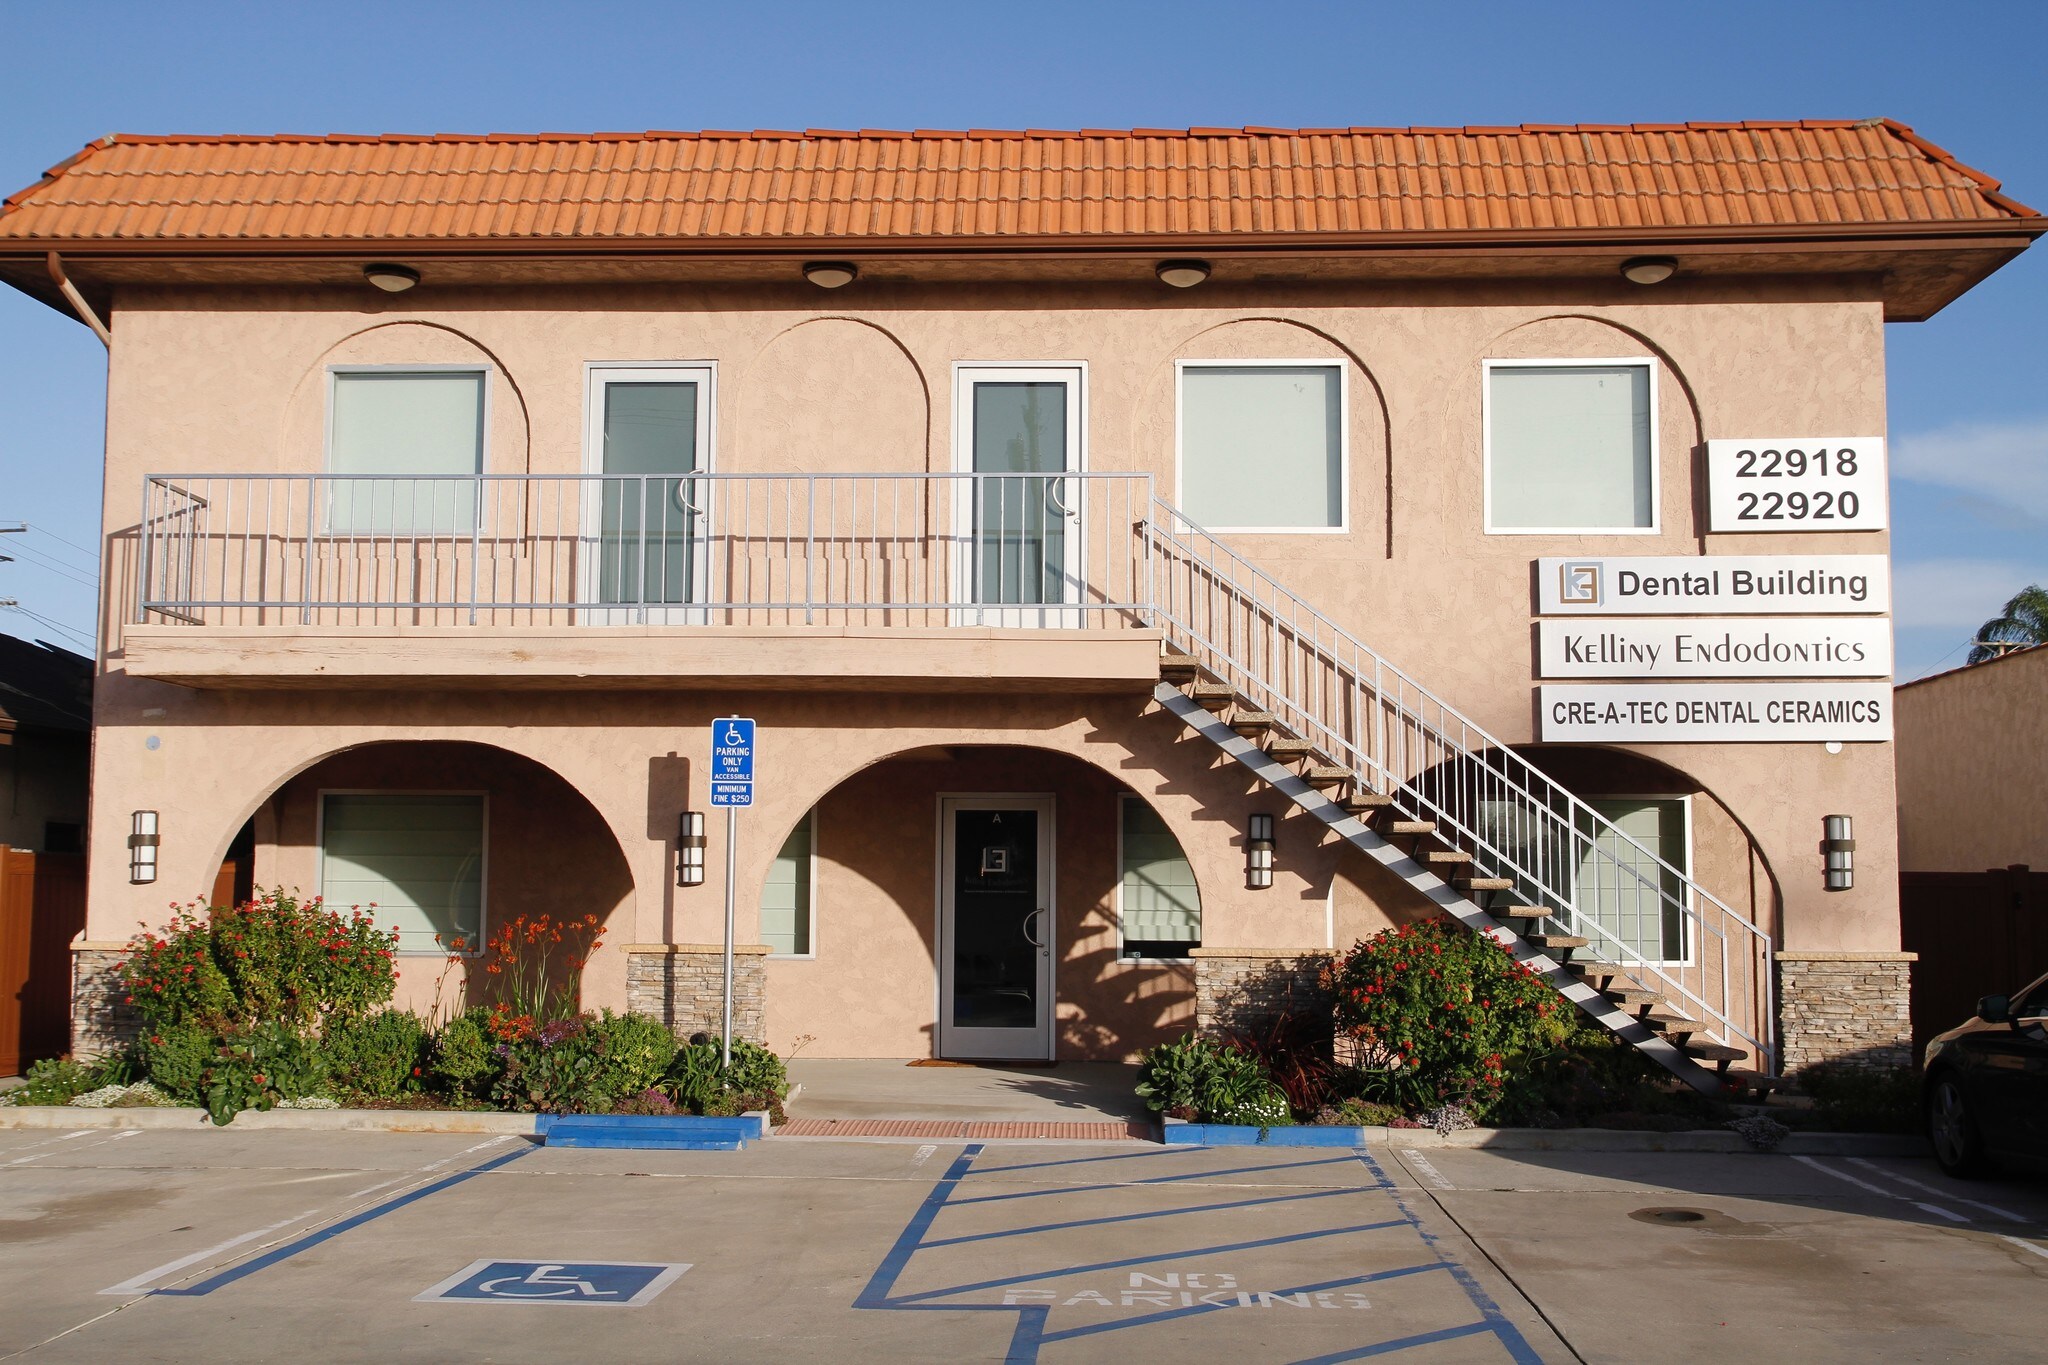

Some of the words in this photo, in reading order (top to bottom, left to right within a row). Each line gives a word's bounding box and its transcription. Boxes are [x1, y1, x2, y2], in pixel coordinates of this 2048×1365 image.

[1736, 448, 1858, 478] 22918
[1737, 490, 1860, 520] 22920
[1618, 570, 1719, 597] Dental
[1732, 570, 1867, 602] Building
[1564, 633, 1661, 671] Kelliny
[1675, 633, 1865, 663] Endodontics
[1552, 701, 1669, 725] CRE-A-TEC
[1675, 701, 1760, 724] DENTAL
[1766, 700, 1881, 724] CERAMICS
[716, 747, 750, 756] PARKING
[722, 757, 743, 766] ONLY
[717, 785, 747, 793] MINIMUM
[713, 794, 729, 803] FINE
[731, 794, 750, 804] $250
[992, 813, 1002, 823] A
[1129, 1272, 1238, 1288] NO
[1002, 1289, 1372, 1310] PARKING
